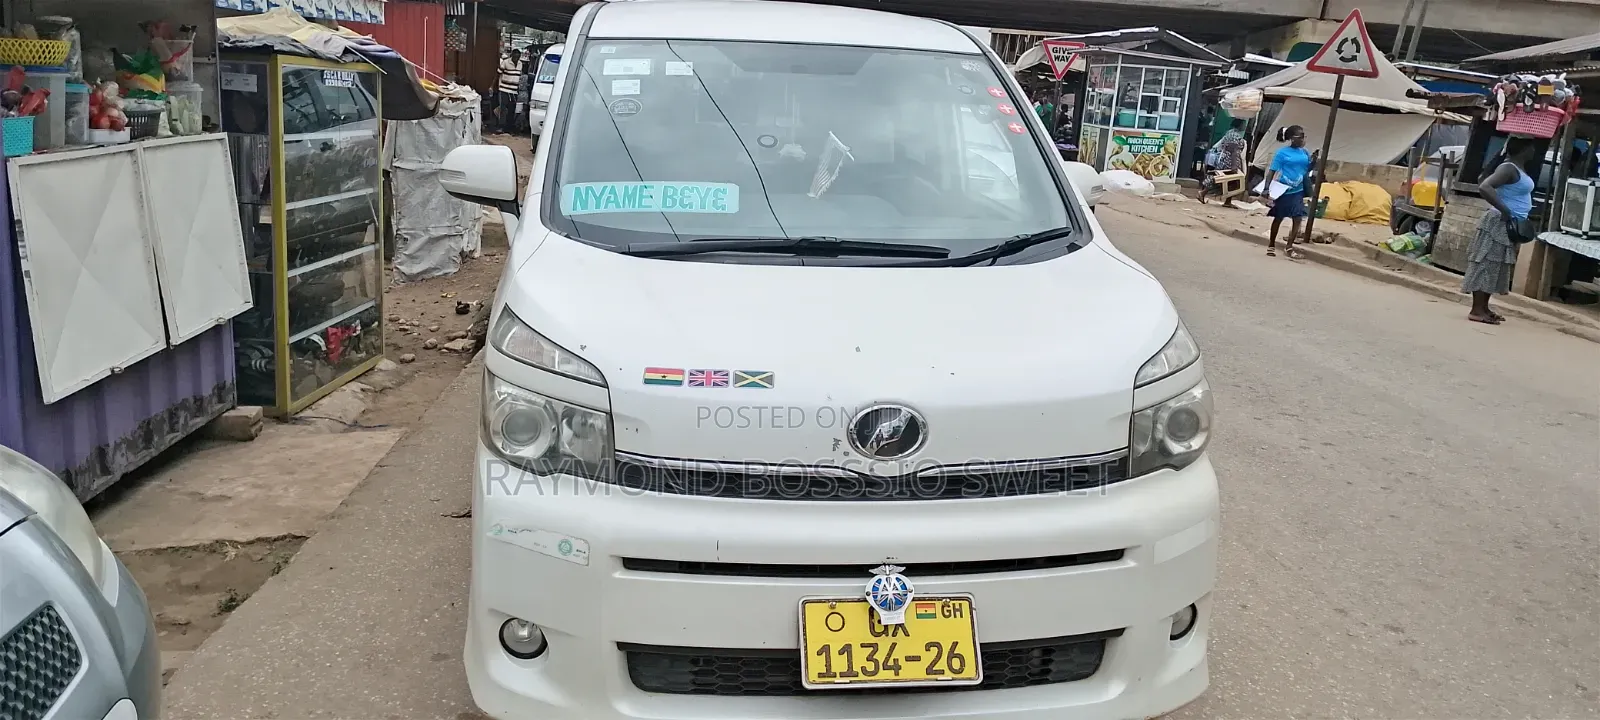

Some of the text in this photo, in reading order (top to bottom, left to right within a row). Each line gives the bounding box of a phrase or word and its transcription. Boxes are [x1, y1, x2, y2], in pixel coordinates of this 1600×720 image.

[1054, 54, 1071, 62] WAY
[1131, 145, 1159, 153] KITCHEN
[572, 185, 655, 212] NYAME
[941, 601, 963, 618] GH
[816, 641, 966, 678] 1134-26
